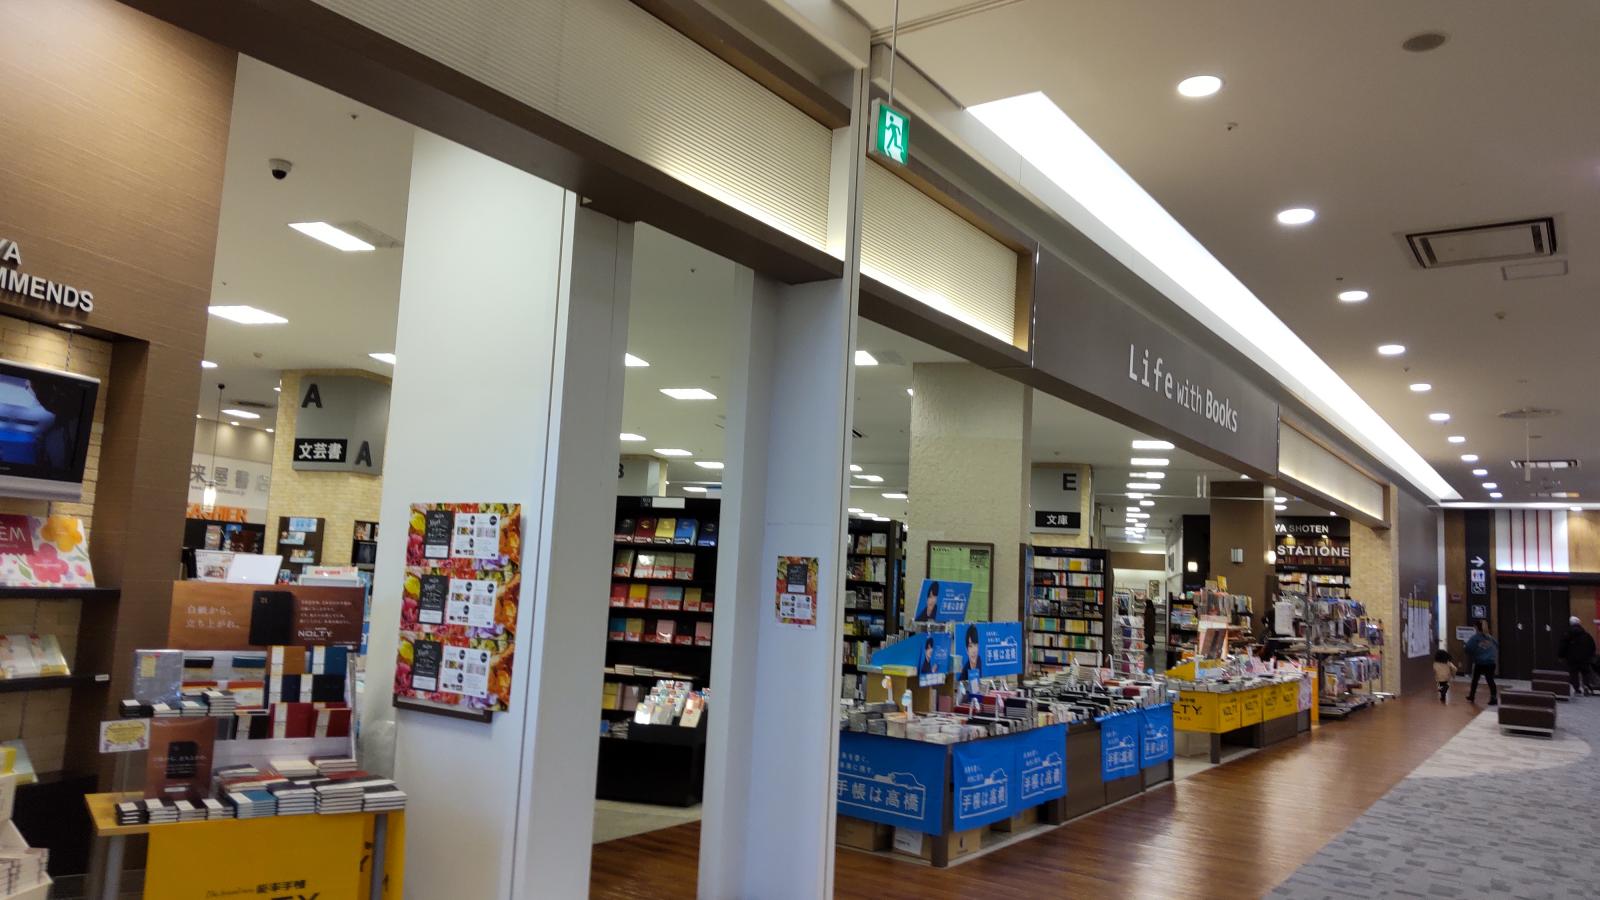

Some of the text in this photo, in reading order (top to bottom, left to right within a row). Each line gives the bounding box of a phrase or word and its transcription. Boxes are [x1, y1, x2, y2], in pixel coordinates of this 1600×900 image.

[301, 383, 322, 408] A
[1129, 344, 1237, 432] Life with Books
[299, 443, 342, 460] 文芸書
[355, 441, 371, 467] A
[1063, 473, 1077, 490] E
[1046, 514, 1068, 525] 文庫
[1289, 524, 1329, 533] SHOTEN
[1277, 545, 1350, 557] STATIONE
[298, 630, 333, 638] NOLTY
